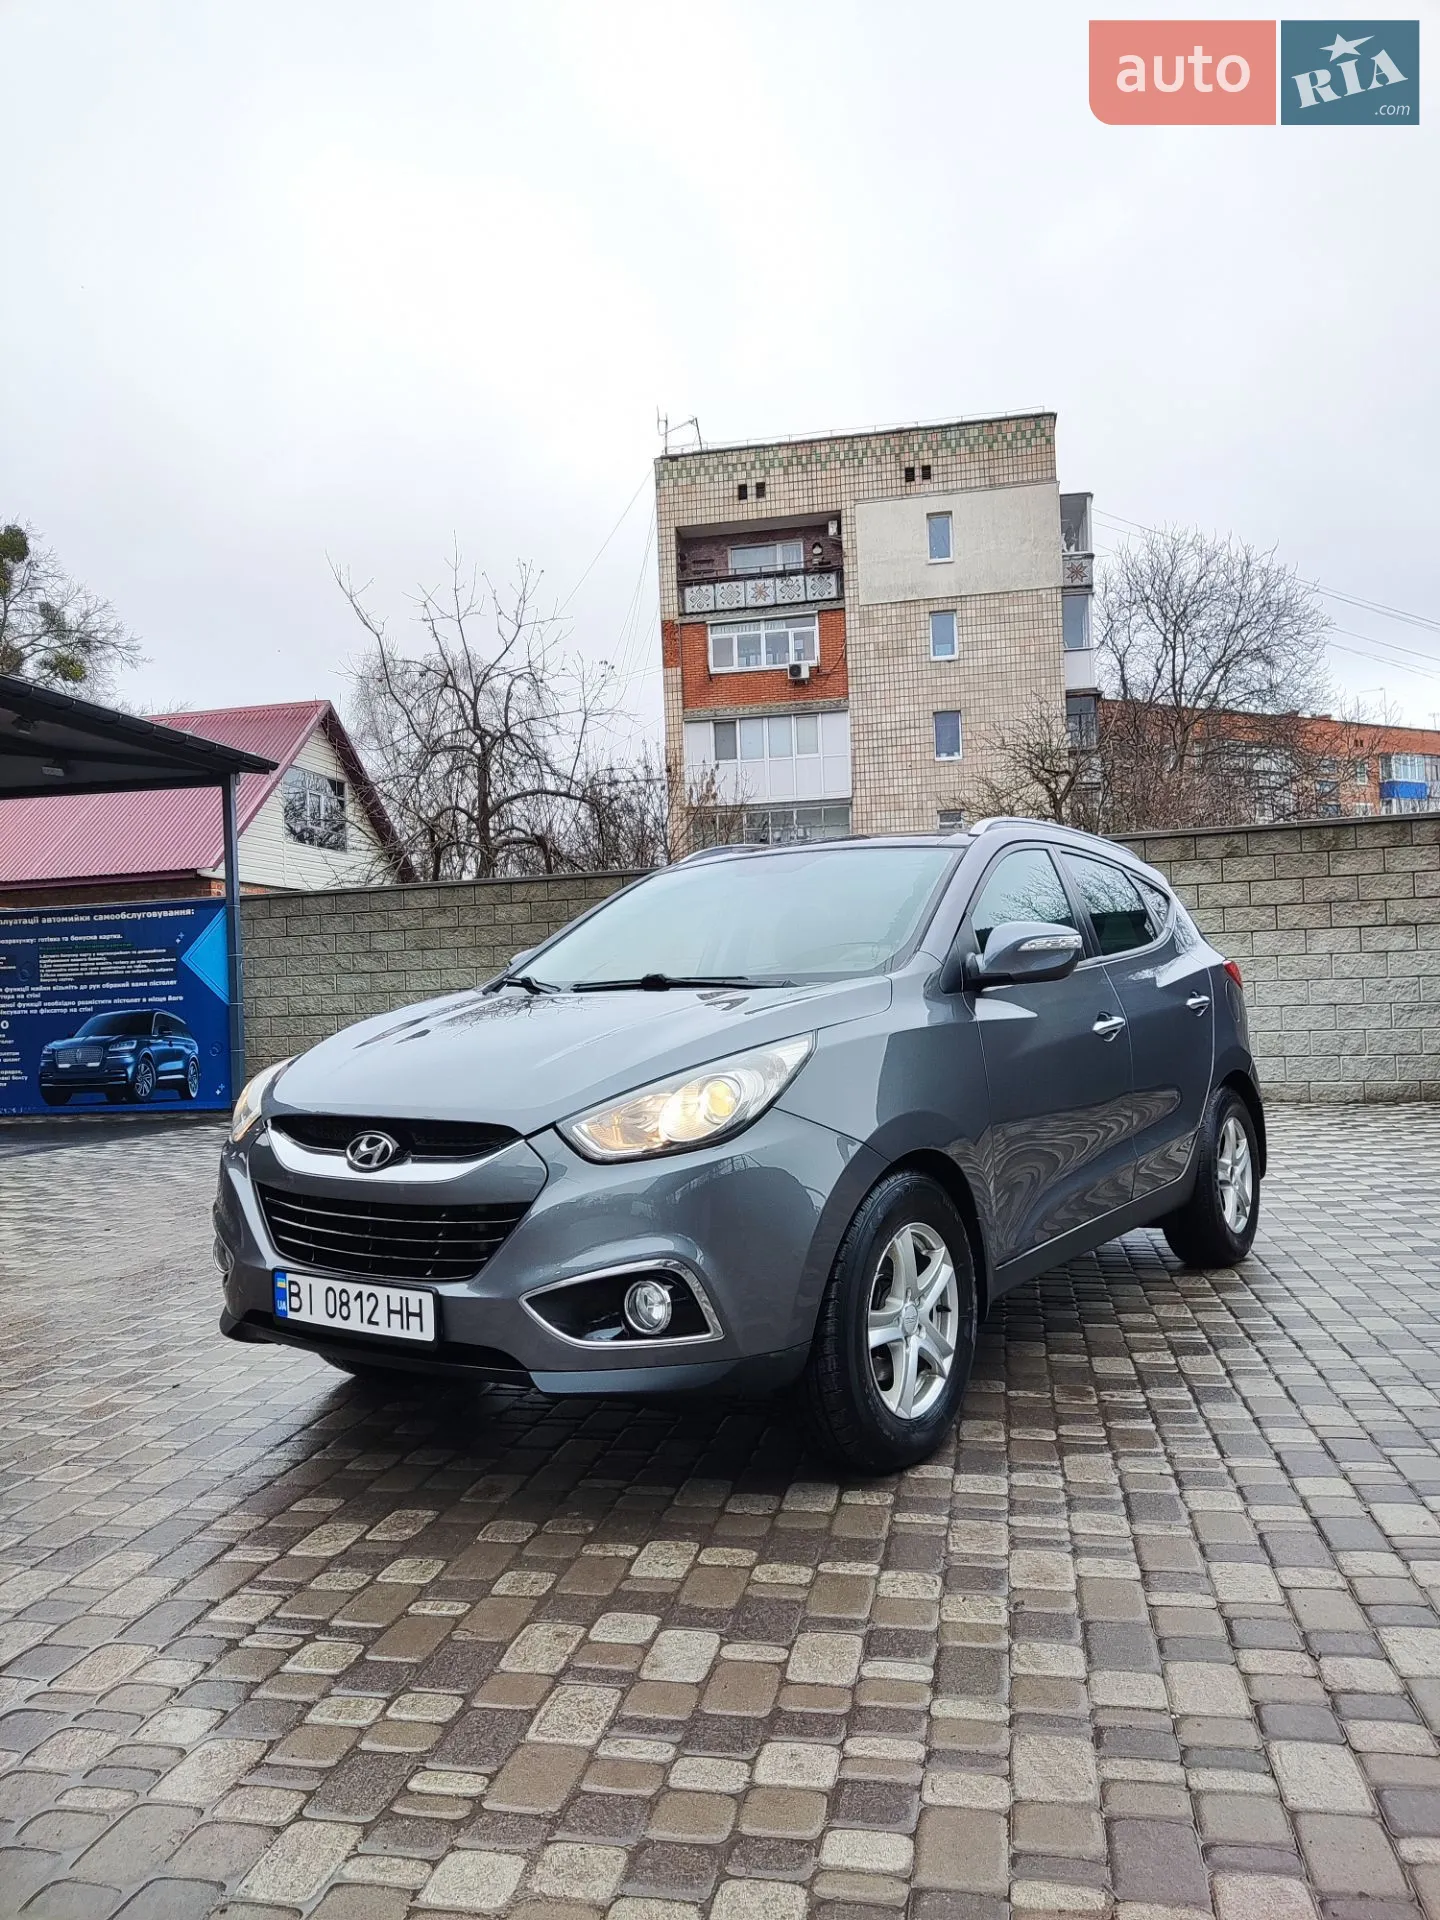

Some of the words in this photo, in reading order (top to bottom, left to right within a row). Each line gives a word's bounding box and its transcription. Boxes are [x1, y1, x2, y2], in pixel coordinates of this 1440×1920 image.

[93, 908, 195, 921] самообслуговування:
[277, 1299, 287, 1311] UA
[288, 1280, 313, 1316] BI
[325, 1286, 379, 1326] 0812
[387, 1294, 424, 1333] HH
